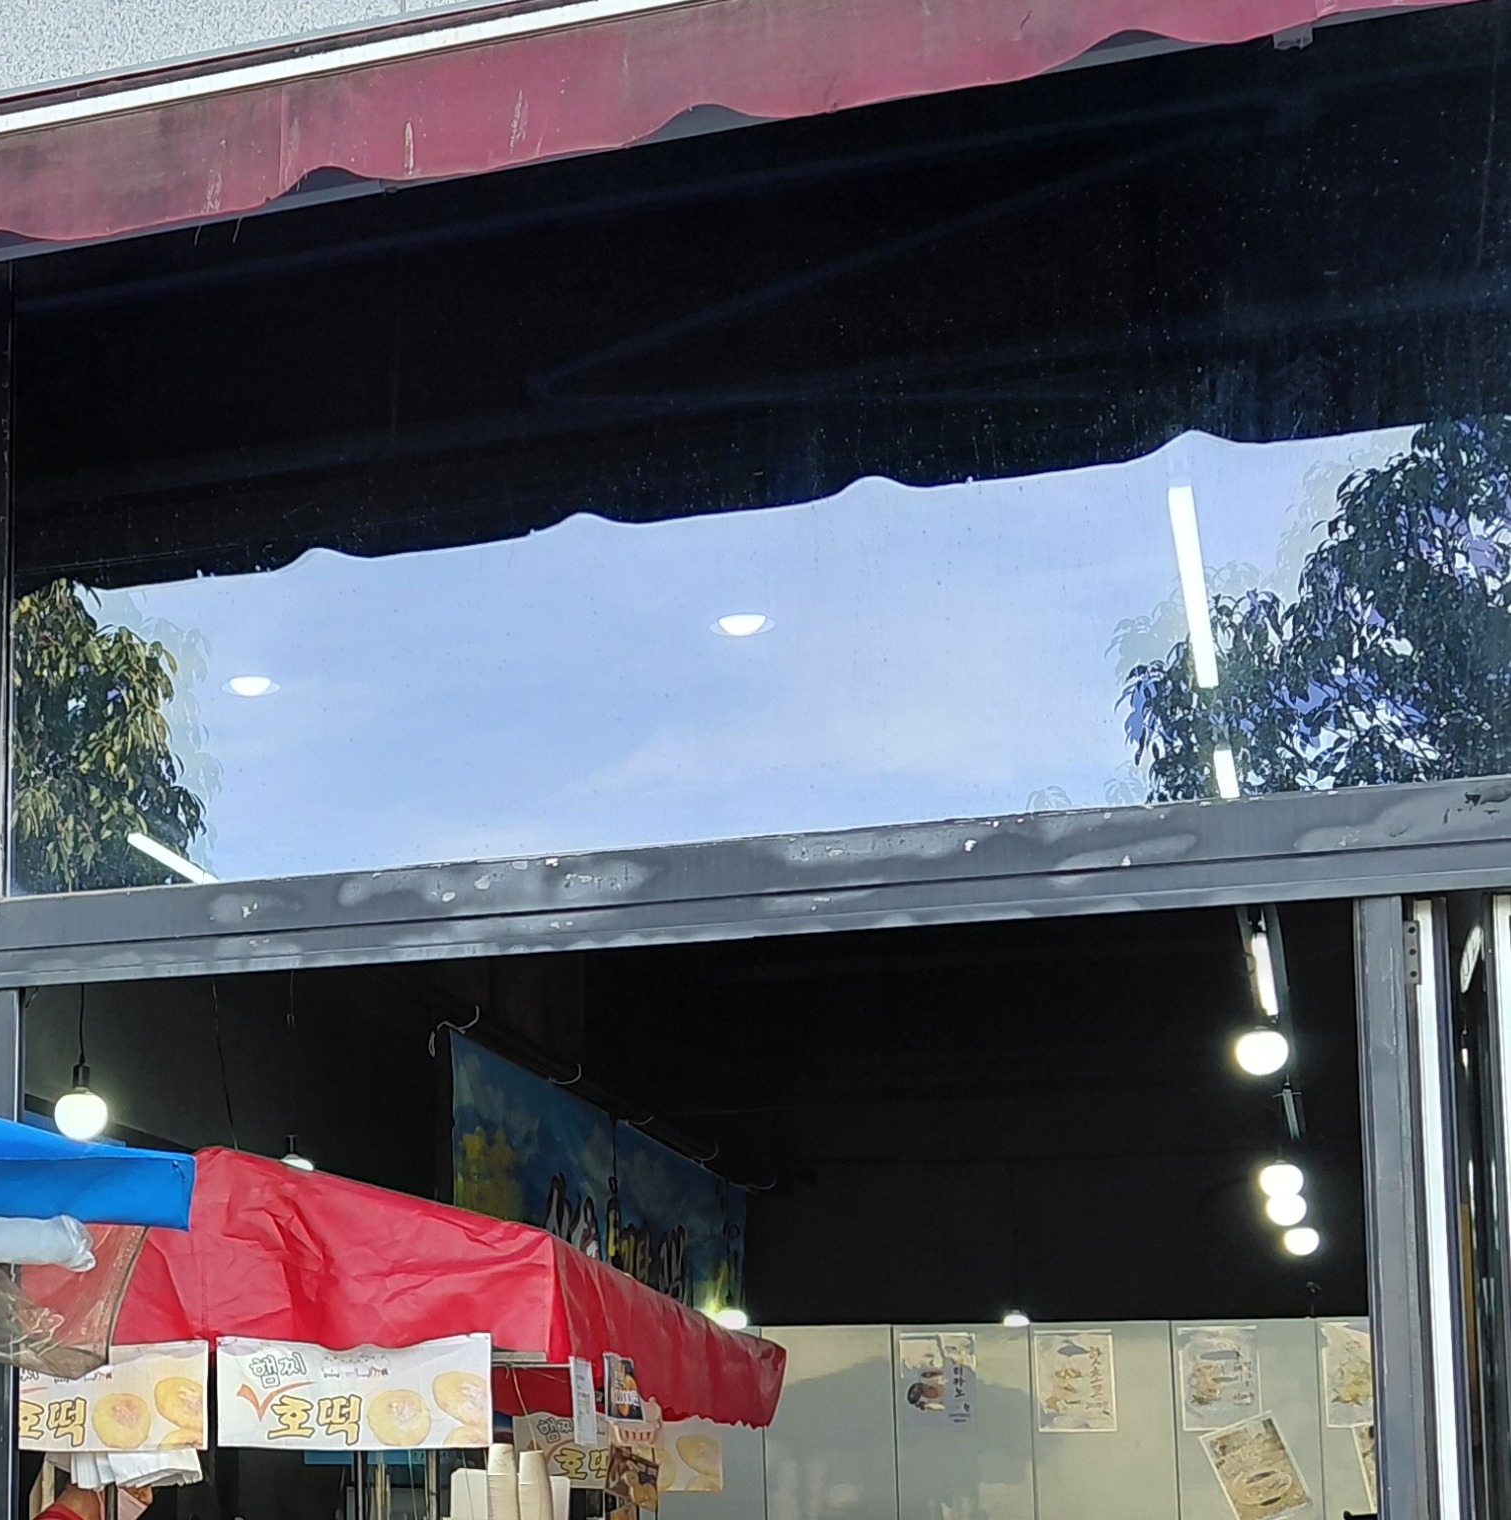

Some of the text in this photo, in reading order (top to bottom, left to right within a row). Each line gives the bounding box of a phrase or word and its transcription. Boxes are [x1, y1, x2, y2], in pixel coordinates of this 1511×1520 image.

[249, 1352, 307, 1389] 햄찌
[19, 1396, 87, 1447] 호떡
[267, 1393, 363, 1446] 호떡
